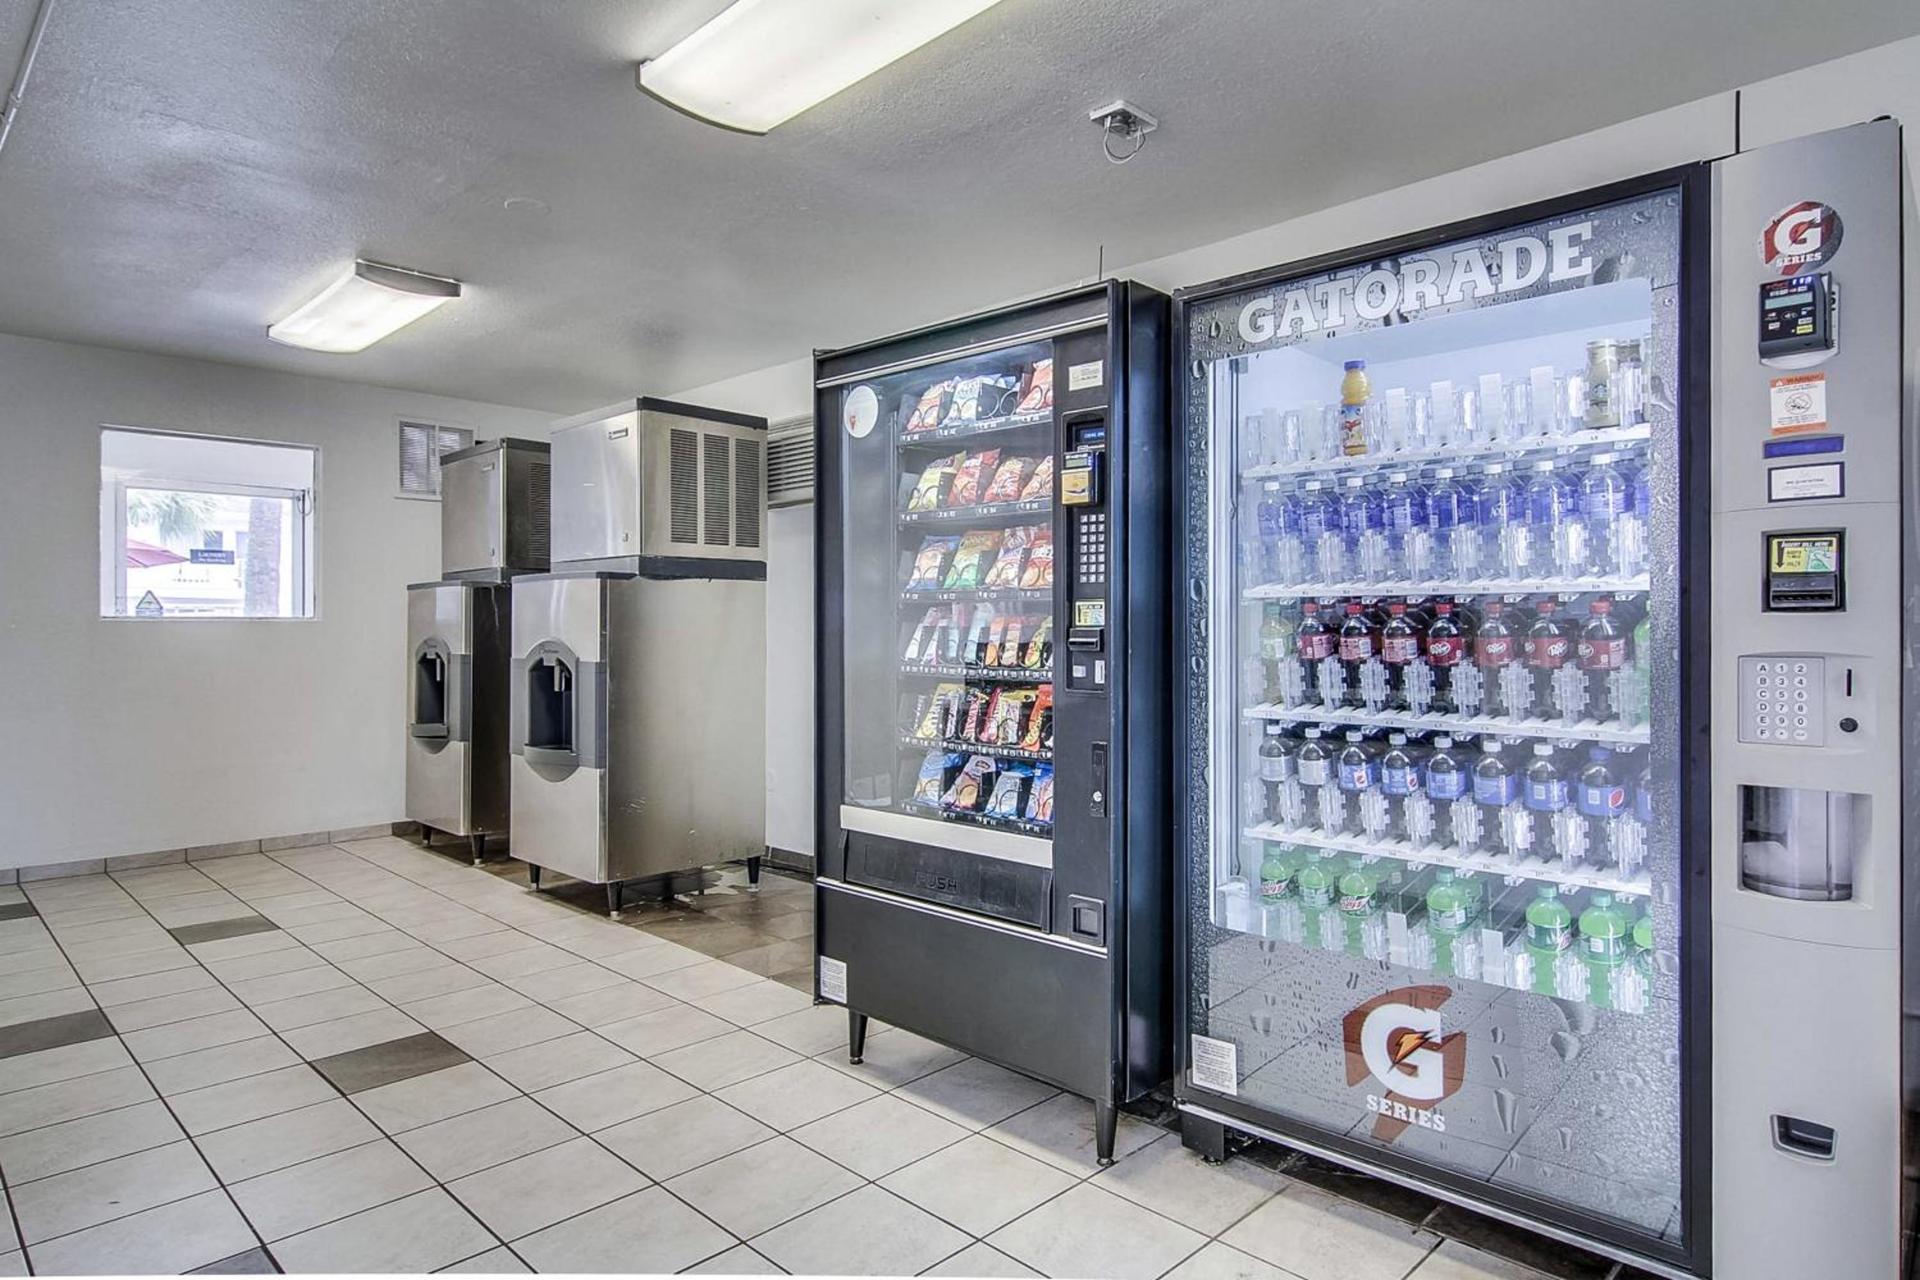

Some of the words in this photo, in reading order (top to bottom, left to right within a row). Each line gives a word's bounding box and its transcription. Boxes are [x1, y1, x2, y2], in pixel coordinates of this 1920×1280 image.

[1773, 208, 1823, 256] G
[1238, 221, 1593, 345] GATORADE
[1776, 252, 1823, 268] SERIES
[1360, 1003, 1445, 1100] G
[1366, 1094, 1446, 1132] SERIES
